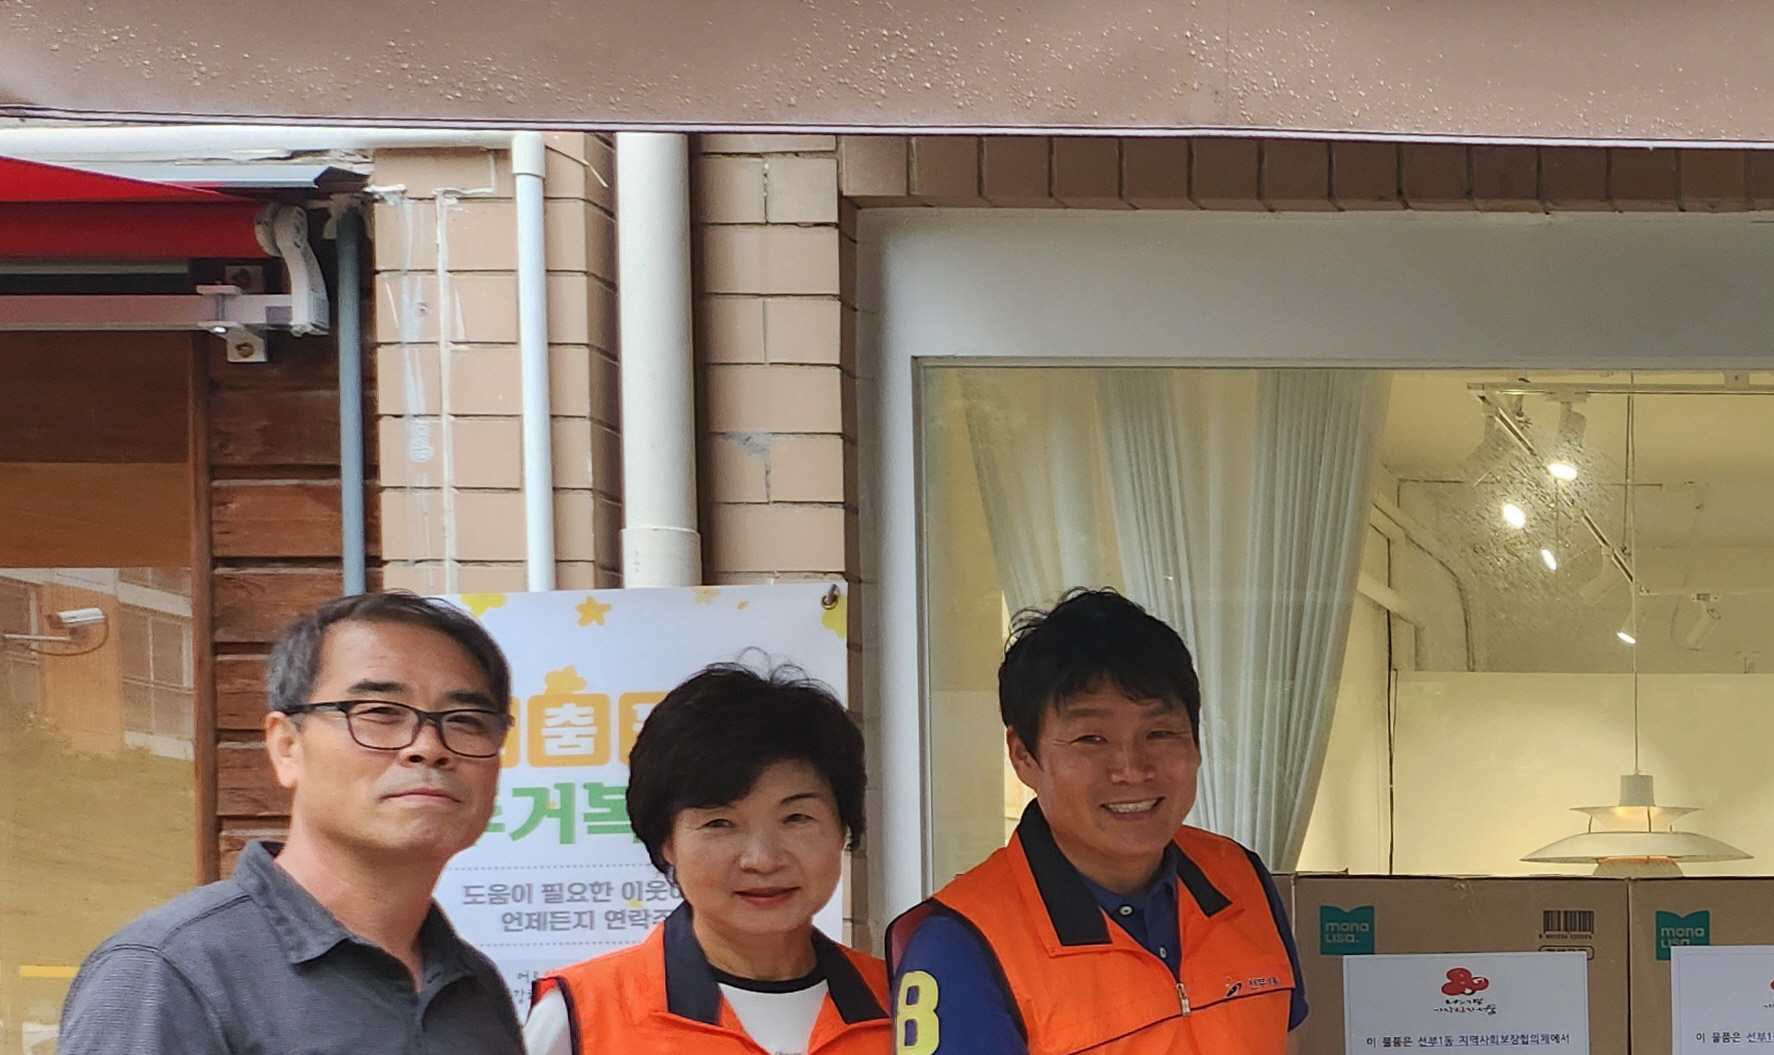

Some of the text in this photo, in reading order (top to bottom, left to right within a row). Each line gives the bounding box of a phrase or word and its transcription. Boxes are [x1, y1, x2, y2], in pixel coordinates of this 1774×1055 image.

[462, 883, 533, 905] 도움이
[541, 881, 614, 904] 필요한
[502, 909, 595, 933] 언제든지
[1325, 921, 1370, 932] mona
[1661, 926, 1705, 937] mona
[1367, 1037, 1376, 1048] 이
[1418, 1036, 1453, 1048] 선부1동
[1696, 1032, 1706, 1043] 이
[1711, 1032, 1742, 1043] 물품은
